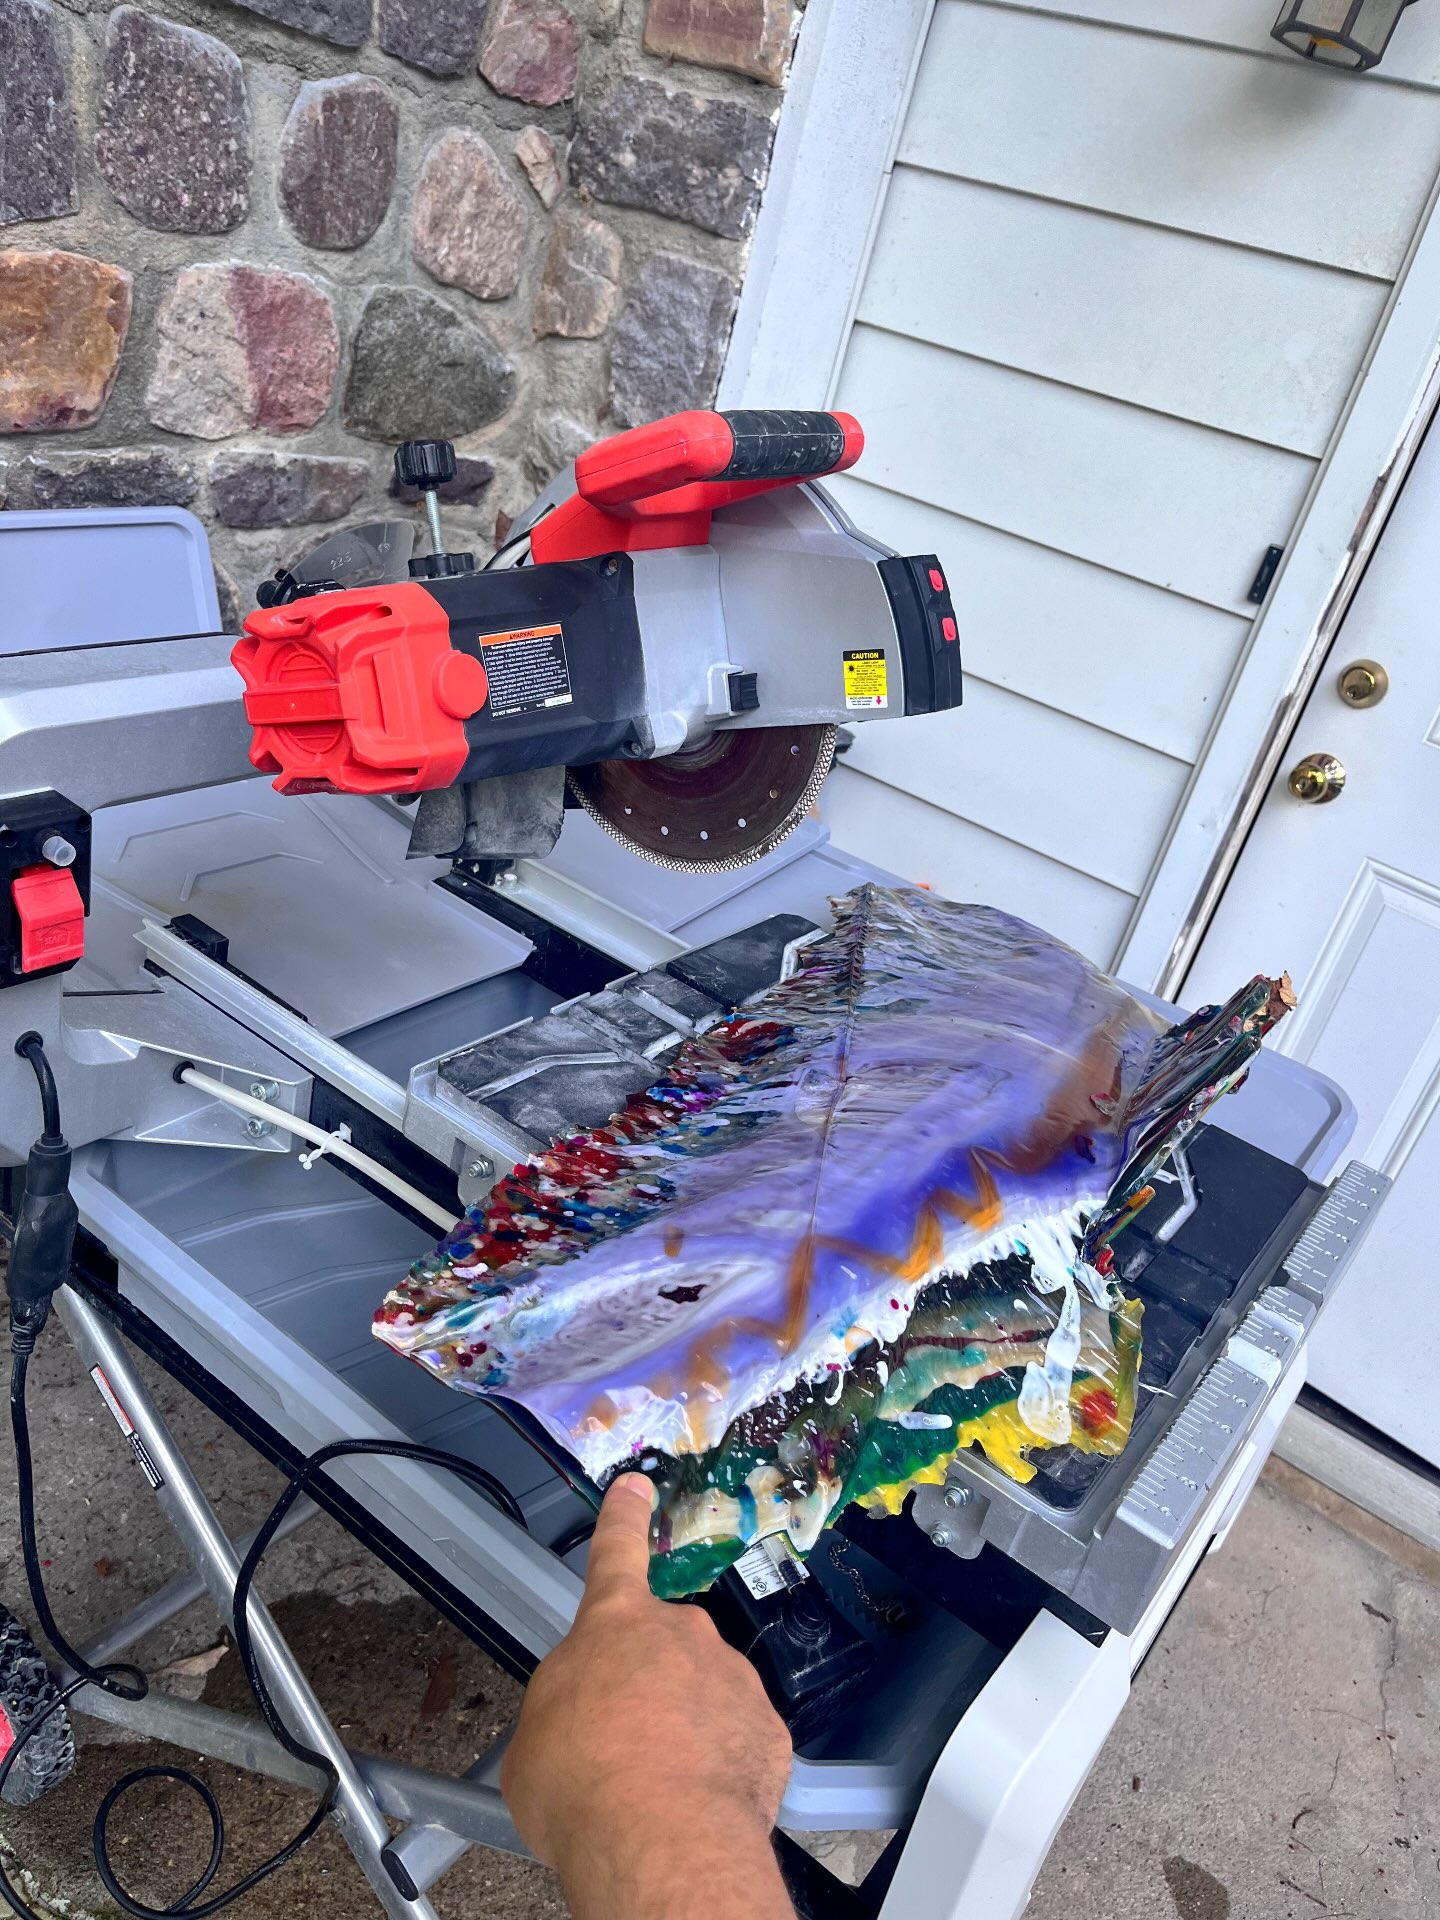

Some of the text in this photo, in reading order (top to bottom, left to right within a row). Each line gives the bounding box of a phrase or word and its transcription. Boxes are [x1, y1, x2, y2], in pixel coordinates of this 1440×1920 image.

[512, 631, 535, 639] WARNING
[1179, 1476, 1199, 1491] 8
[1198, 1446, 1218, 1465] 7
